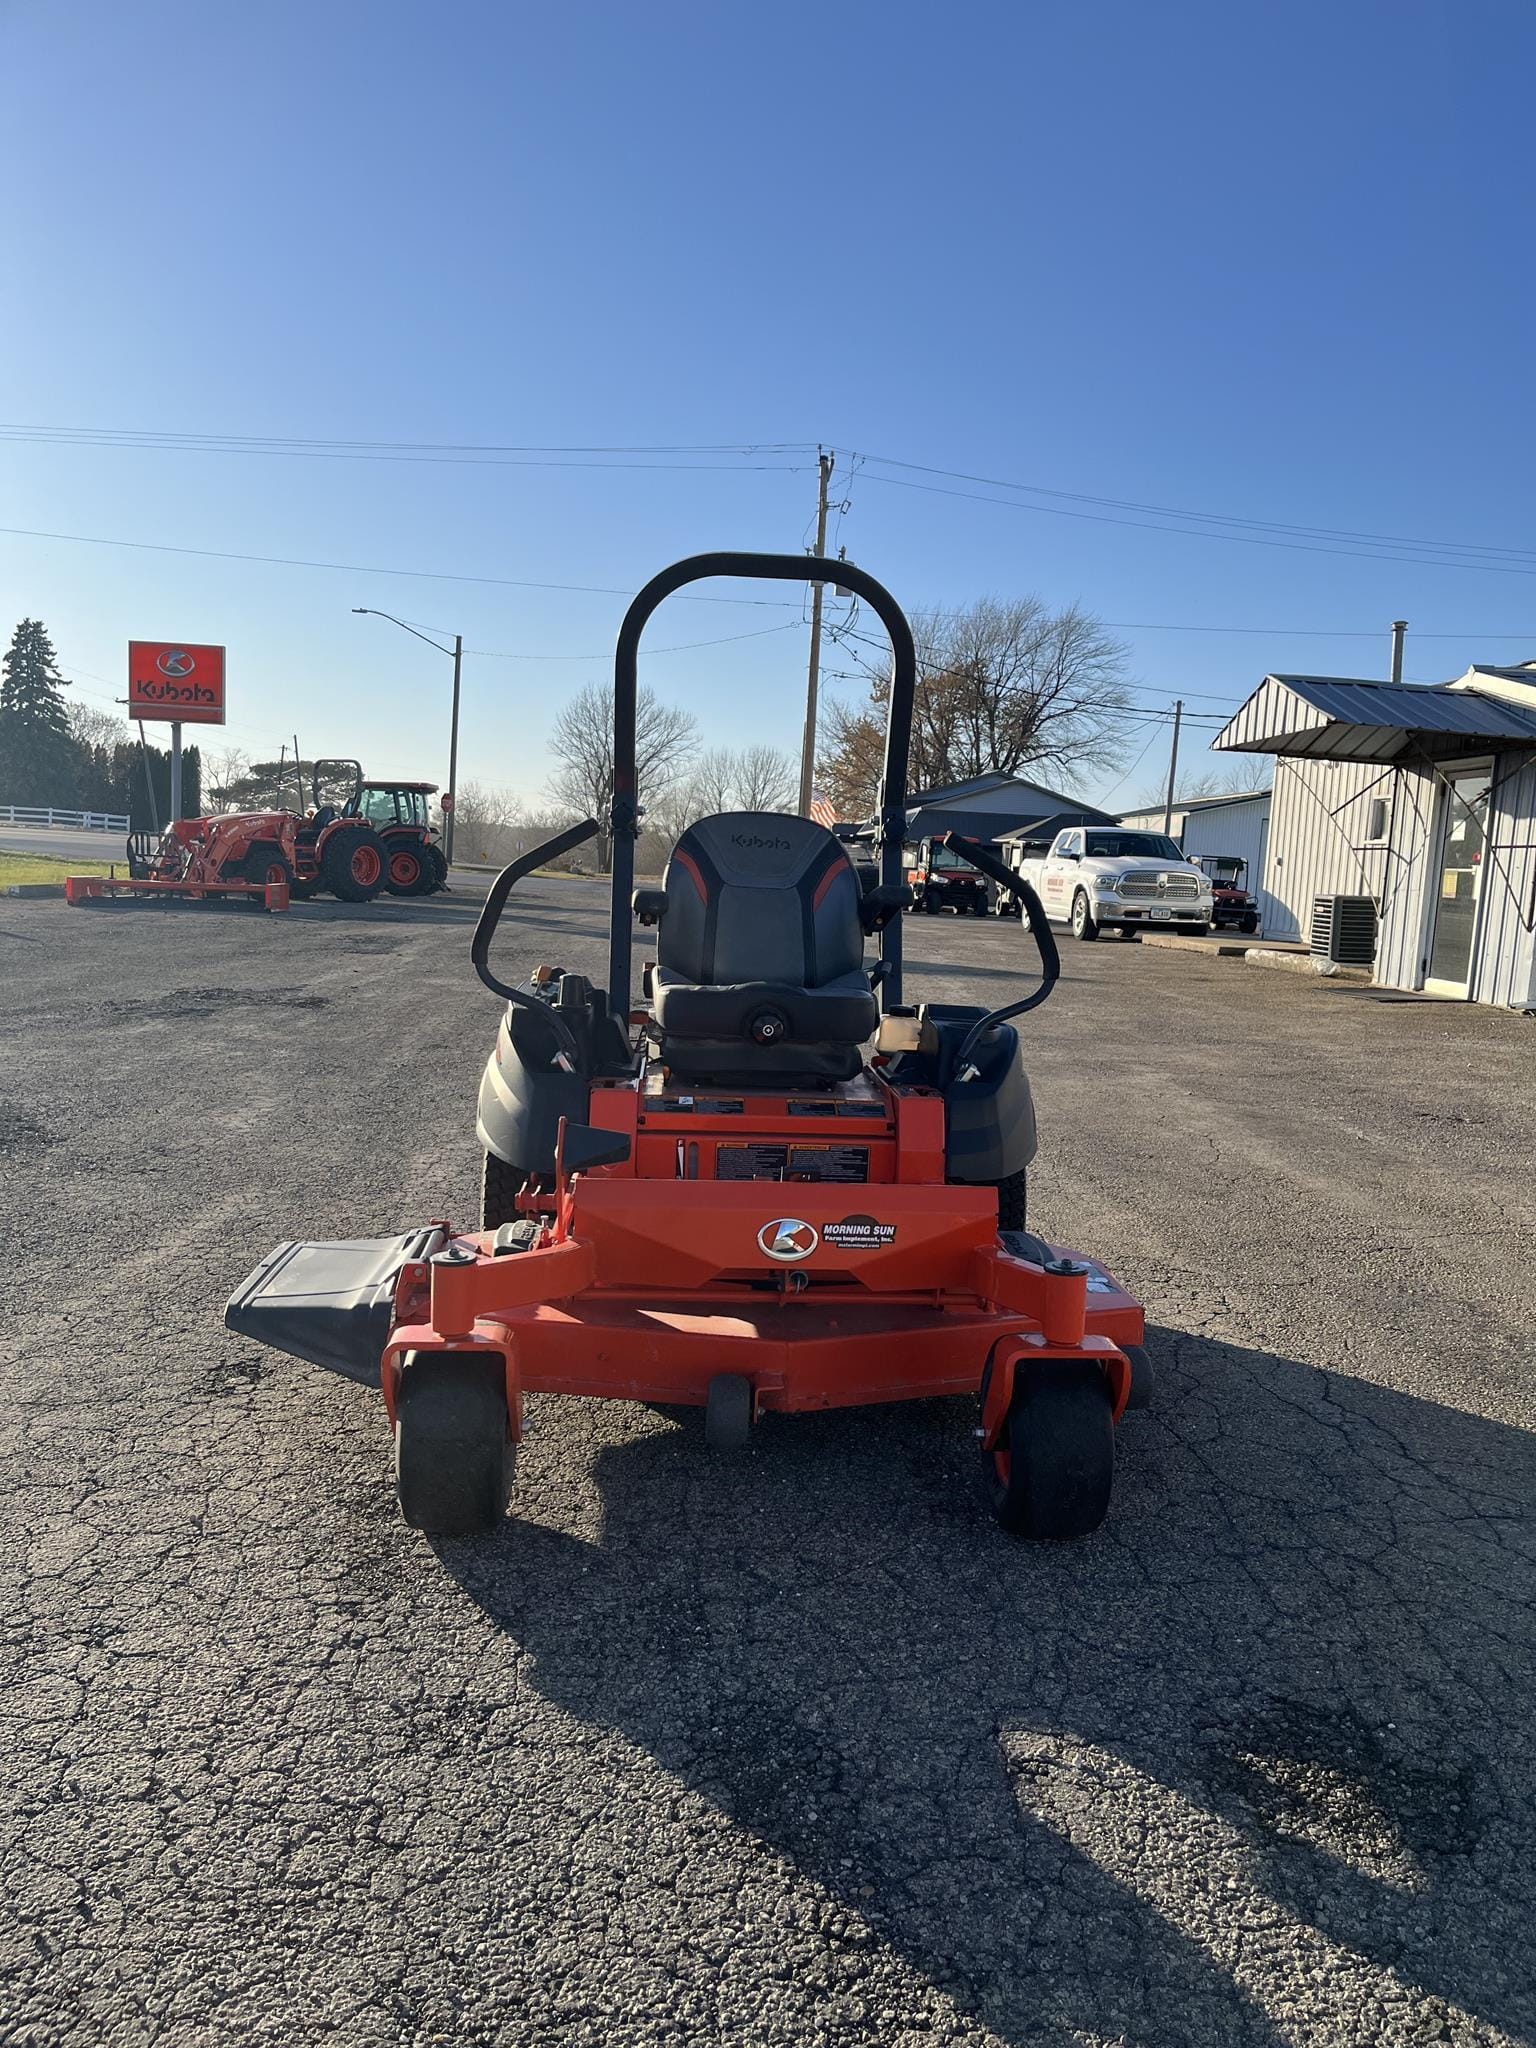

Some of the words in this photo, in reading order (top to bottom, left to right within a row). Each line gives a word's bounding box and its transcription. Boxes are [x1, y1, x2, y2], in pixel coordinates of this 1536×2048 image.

[137, 680, 215, 702] Kubota
[731, 834, 791, 850] Kubota
[823, 1225, 871, 1235] MORNING
[873, 1226, 895, 1235] SUN
